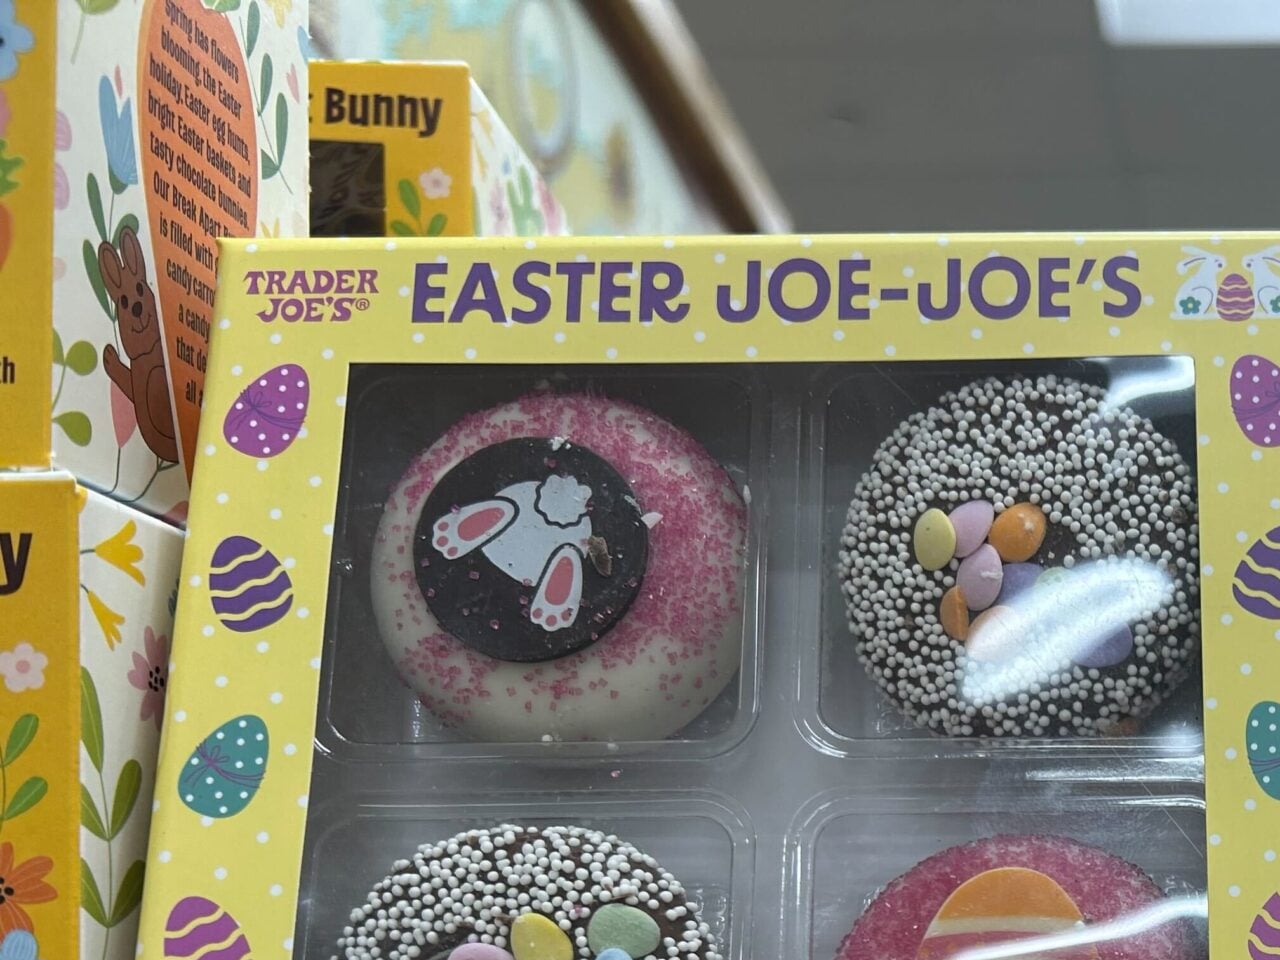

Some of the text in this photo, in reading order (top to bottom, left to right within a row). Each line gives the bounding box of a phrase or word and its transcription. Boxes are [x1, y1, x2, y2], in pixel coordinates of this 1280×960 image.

[195, 20, 209, 54] has
[211, 38, 239, 84] flowers
[184, 84, 210, 126] Easter
[212, 113, 226, 146] egg
[203, 66, 216, 96] the
[218, 80, 242, 121] Easter
[325, 87, 443, 138] Bunny
[148, 88, 251, 199] bright Easter baskets and
[150, 131, 175, 172] tasty
[176, 153, 216, 202] chocolate
[153, 170, 170, 202] Our
[172, 184, 197, 223] Break
[199, 206, 221, 238] Apart
[160, 211, 168, 238] is
[170, 220, 193, 257] filled
[194, 241, 213, 272] with
[166, 258, 193, 296] candy
[243, 269, 379, 295] TRADER
[411, 255, 1142, 324] EASTER JOE-JOE'S
[176, 336, 195, 367] that
[185, 308, 211, 344] candy
[185, 379, 196, 405] all
